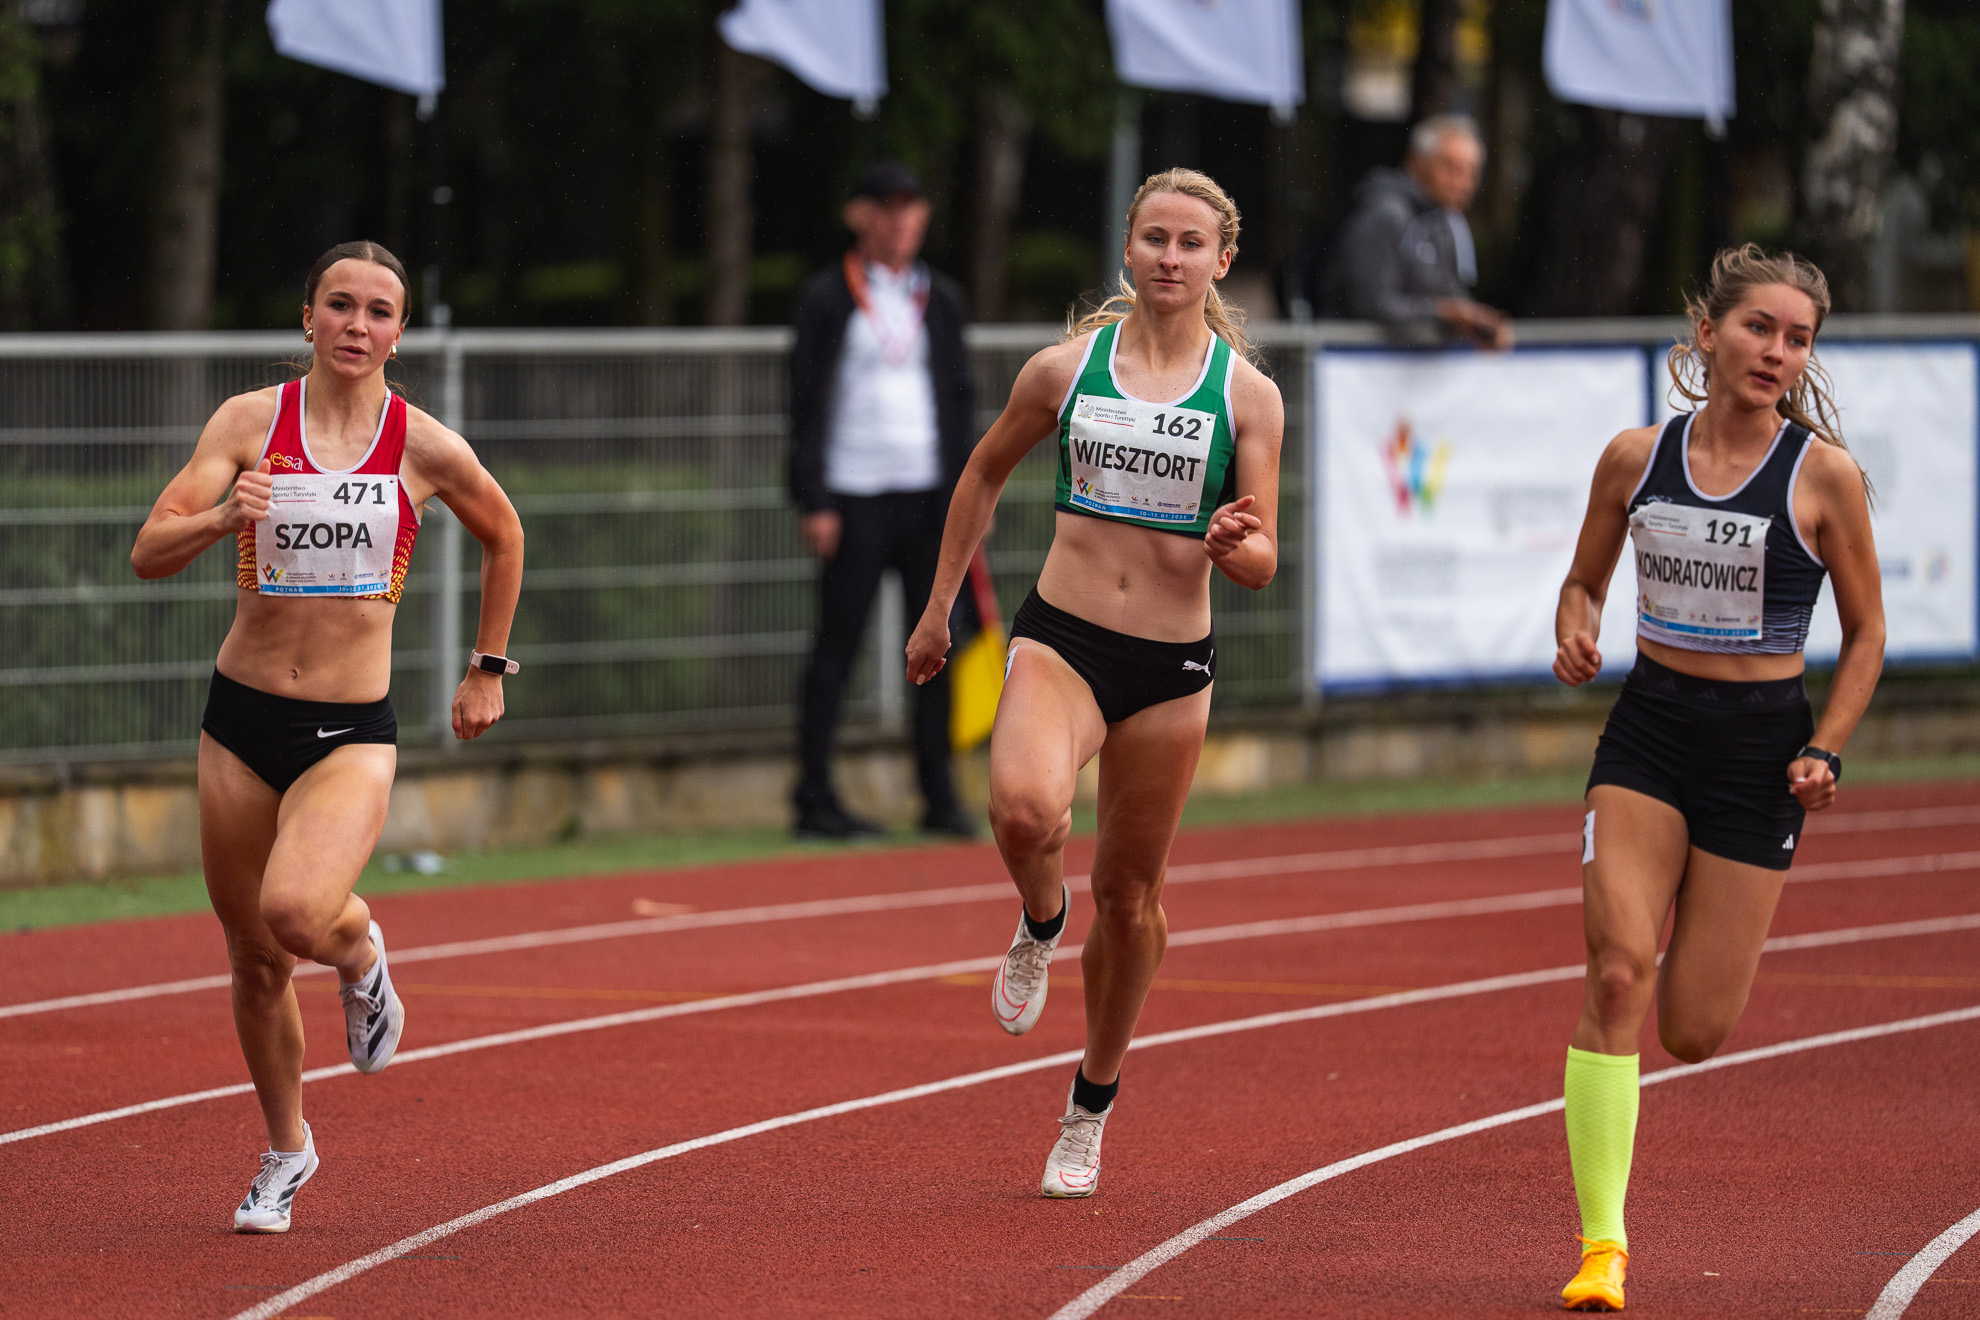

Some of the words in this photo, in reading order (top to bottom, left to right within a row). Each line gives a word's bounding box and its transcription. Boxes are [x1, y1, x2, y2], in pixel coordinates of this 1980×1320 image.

[1095, 406, 1127, 415] Ministerstwo
[1114, 414, 1136, 422] Turystyki
[1152, 413, 1202, 441] 162
[1073, 438, 1200, 482] WIESZTORT
[333, 482, 386, 505] 471
[275, 522, 373, 550] SZOPA
[1705, 519, 1752, 548] 191
[1637, 549, 1759, 593] KONDRATOWICZ
